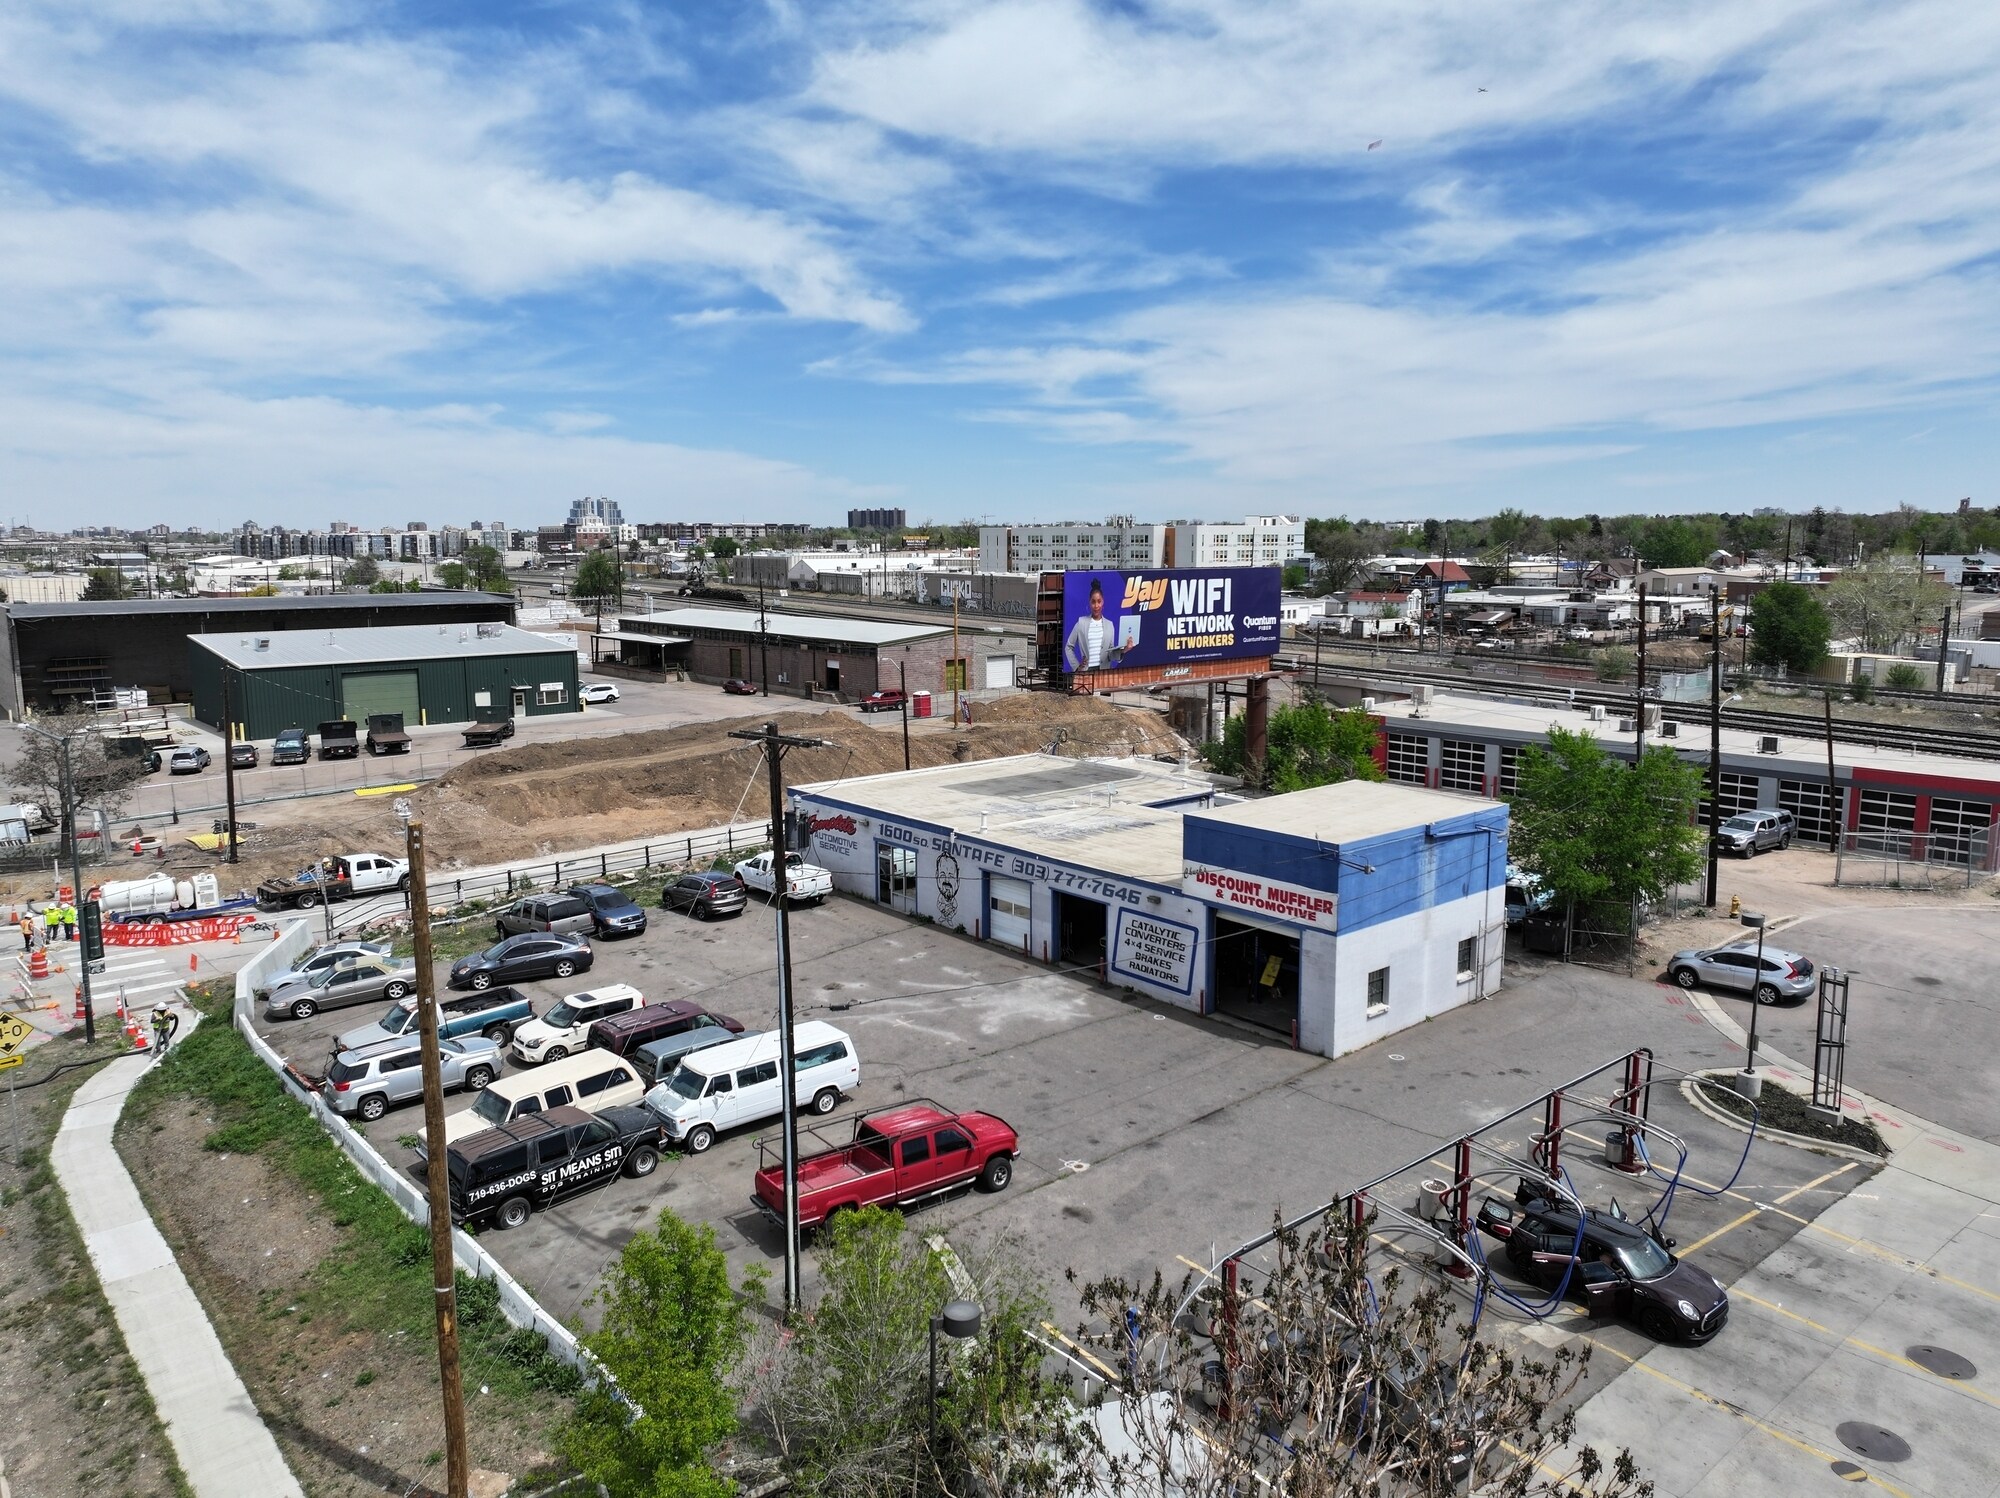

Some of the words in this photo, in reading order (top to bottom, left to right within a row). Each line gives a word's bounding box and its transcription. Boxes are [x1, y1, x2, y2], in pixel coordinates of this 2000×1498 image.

[1139, 602, 1150, 611] TO
[1171, 578, 1231, 615] WIFI
[1167, 614, 1235, 635] NETWORK
[1243, 616, 1277, 628] Quantum
[1166, 633, 1235, 650] NETWORKERS
[814, 831, 858, 850] AUTOMOTIVE
[820, 841, 850, 857] SERVICE
[879, 823, 913, 843] 1600
[1012, 857, 1050, 882] (303)
[1196, 872, 1262, 896] DISCOUNT
[1268, 887, 1334, 915] MUFFLER
[1215, 889, 1225, 899] &
[1231, 892, 1317, 921] AUTOMOTIVE
[1125, 926, 1187, 952] CONVERTERS
[1131, 919, 1182, 941] CATALYTIC
[1135, 951, 1173, 970] BRAKES
[1144, 943, 1187, 963] SERVICE
[1129, 961, 1180, 984] RADIATORS
[541, 1170, 557, 1186] SIT
[560, 1154, 602, 1179] MEANS
[542, 1181, 564, 1193] DOG
[569, 1160, 618, 1183] TRAINING
[468, 1170, 537, 1202] 719-636-DOGS
